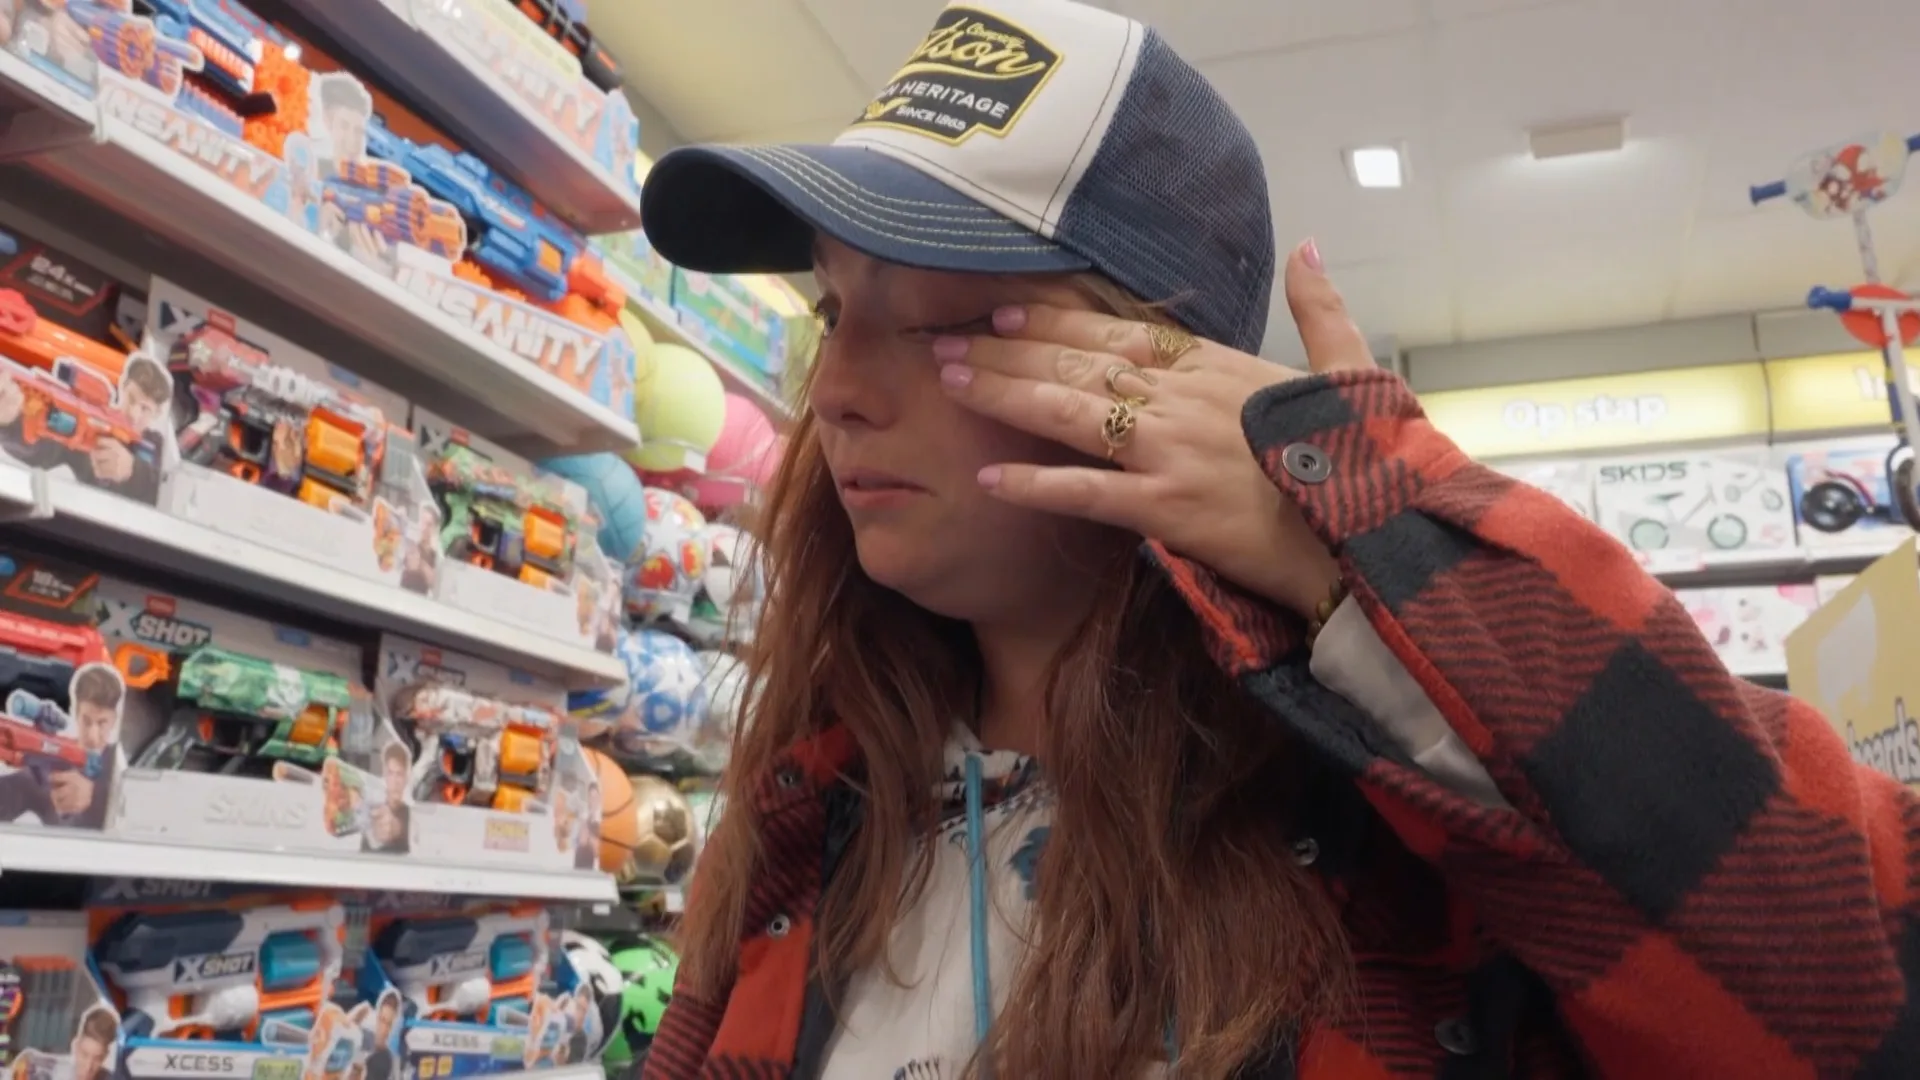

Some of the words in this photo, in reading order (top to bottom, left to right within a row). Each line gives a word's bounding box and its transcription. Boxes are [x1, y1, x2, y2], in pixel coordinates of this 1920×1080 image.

[896, 105, 934, 122] SINCE
[900, 80, 1010, 119] HERITAGE
[1503, 399, 1566, 442] Op
[1574, 394, 1667, 430] stap
[164, 1053, 234, 1072] XCESS
